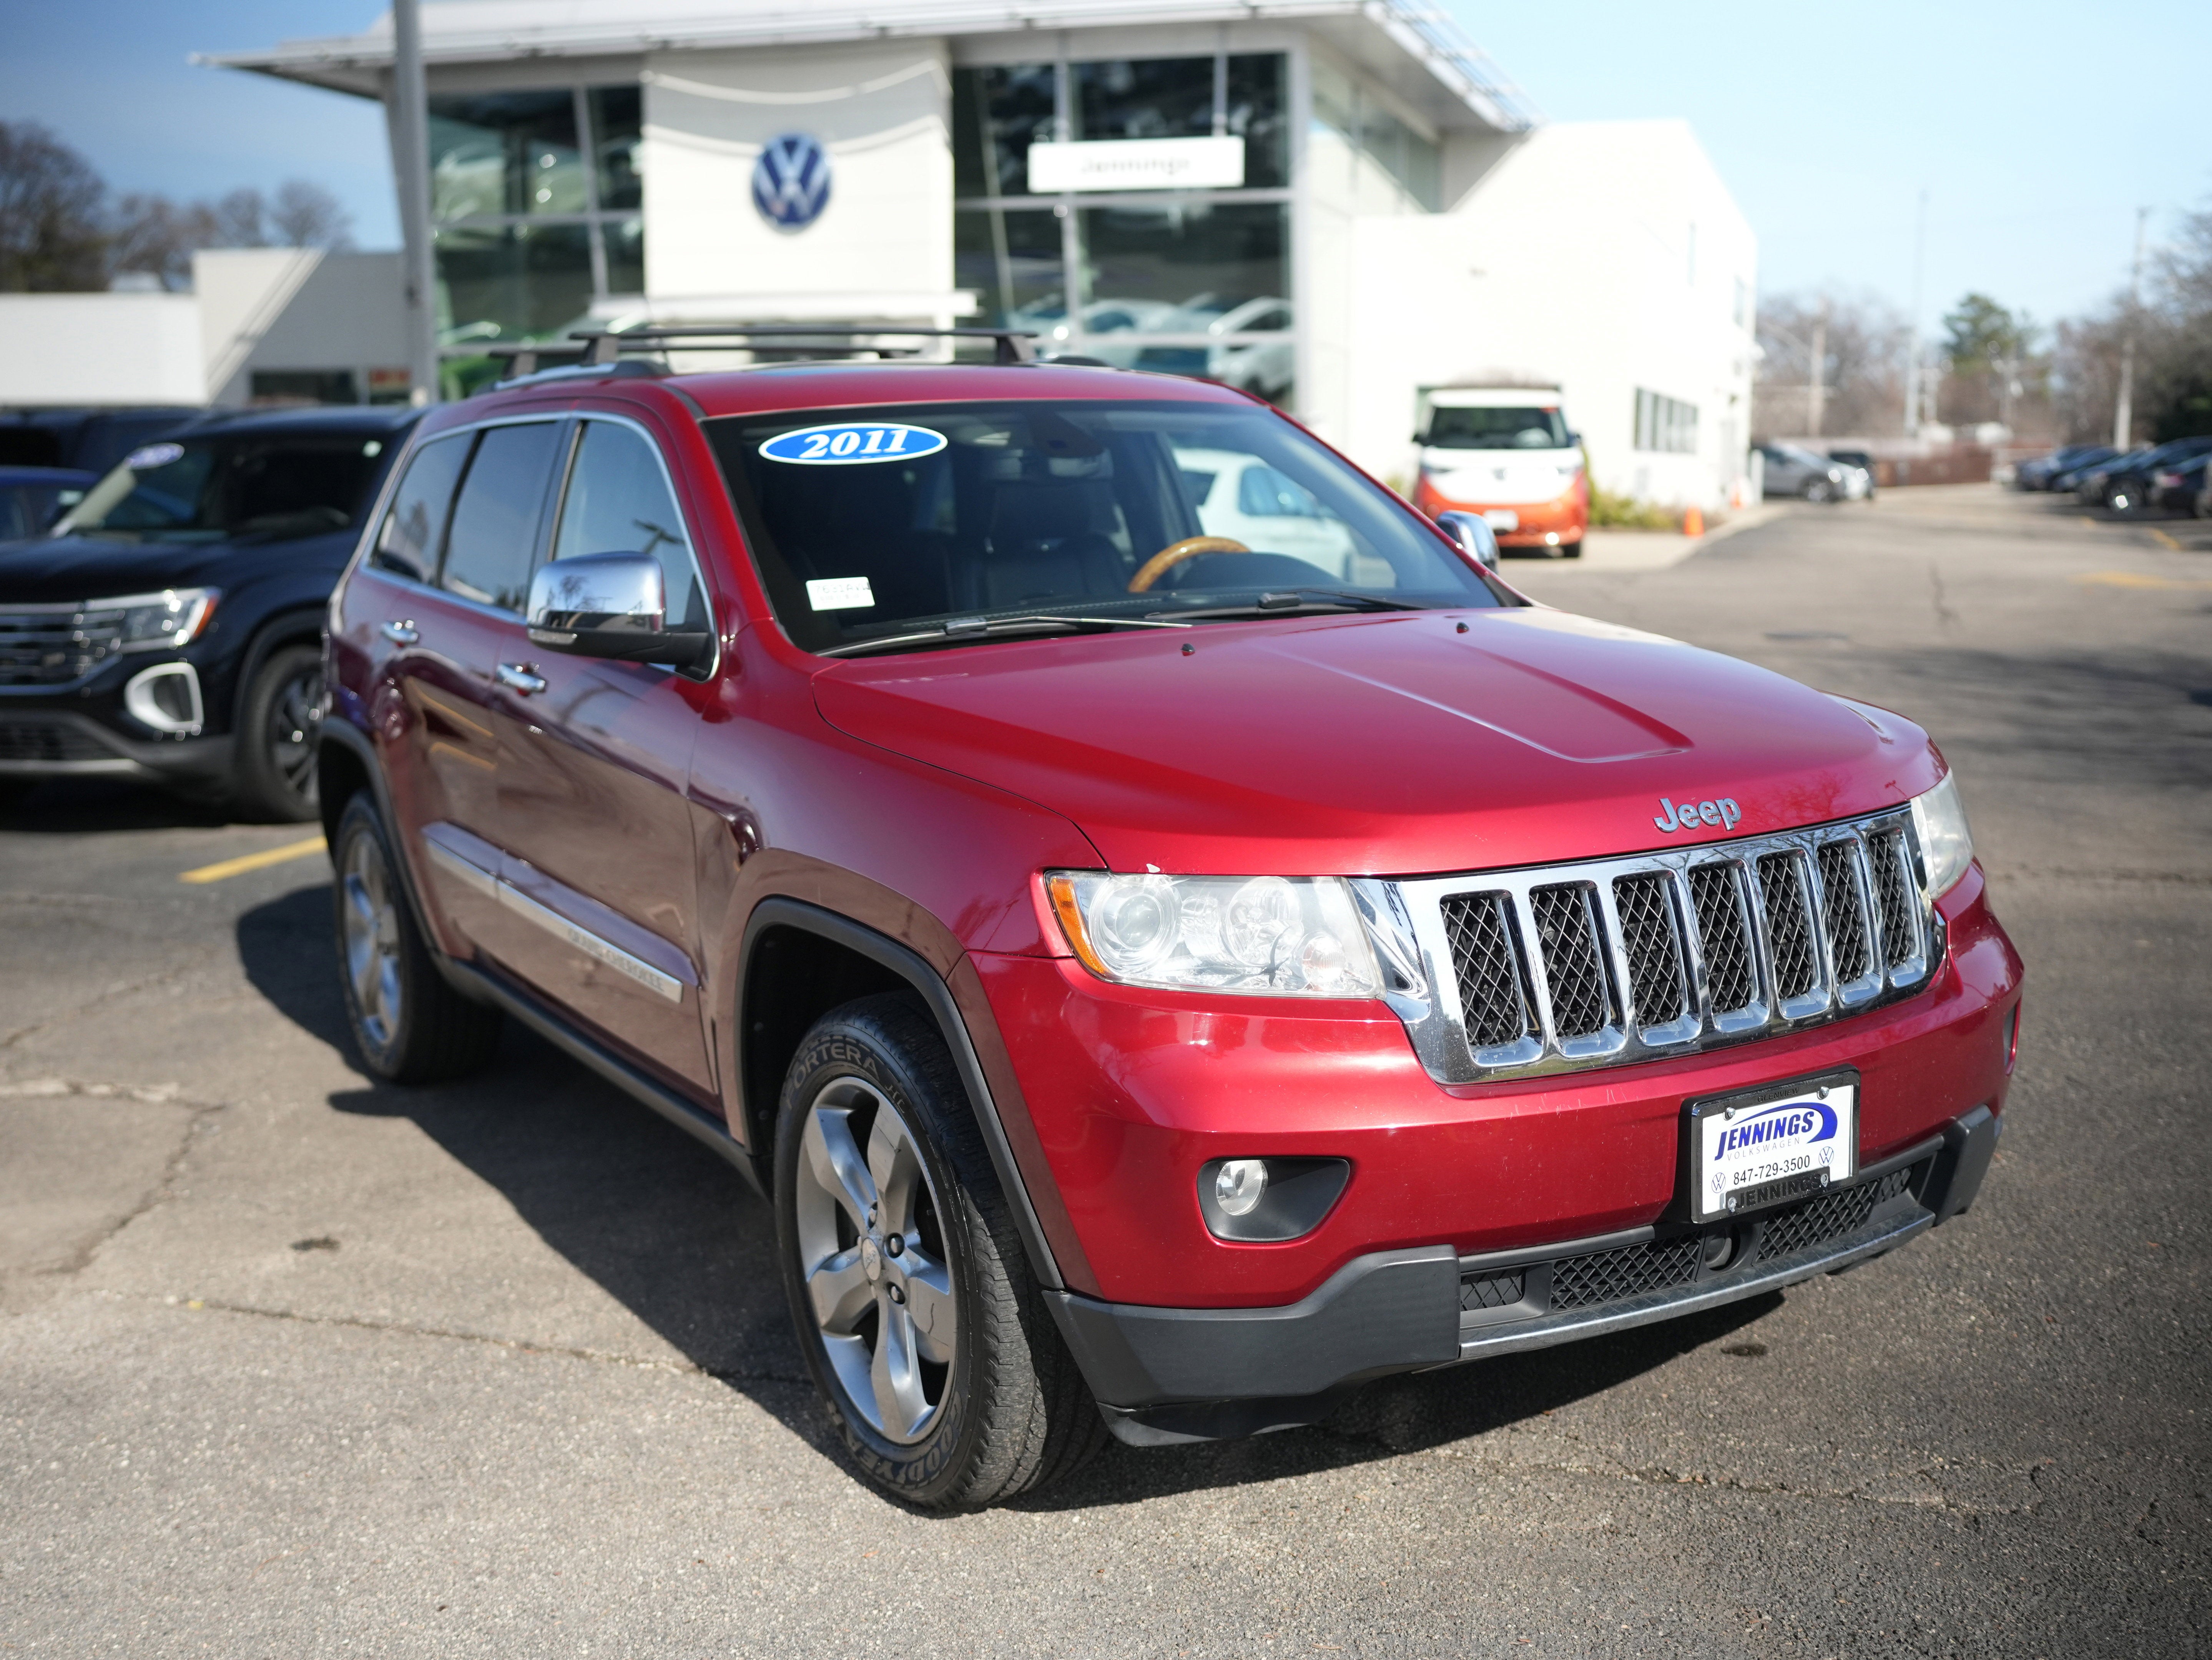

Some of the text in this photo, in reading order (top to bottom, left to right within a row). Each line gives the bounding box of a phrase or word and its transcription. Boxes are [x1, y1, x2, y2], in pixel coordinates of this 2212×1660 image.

[799, 429, 908, 458] 2011
[1653, 797, 1742, 833] Jeep
[1757, 1087, 1800, 1102] GLENVIEW
[1714, 1111, 1815, 1161] JENNINGS
[1727, 1137, 1800, 1161] VOLKSWAGEN
[1733, 1155, 1810, 1185] 847-729-3500
[1736, 1173, 1821, 1208] JENNINGS
